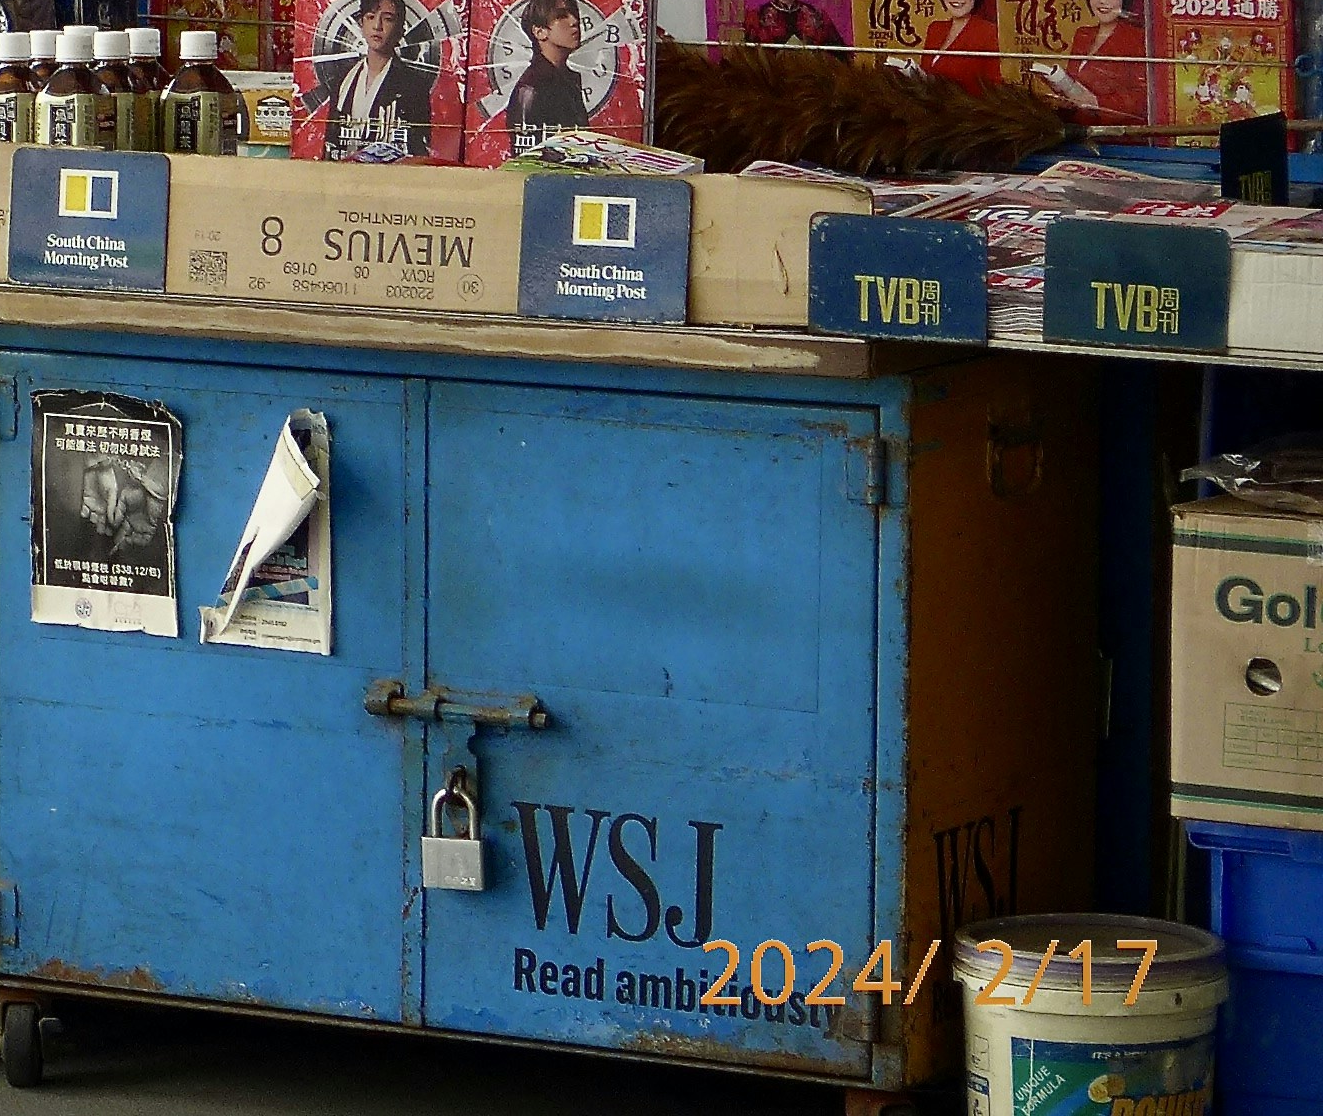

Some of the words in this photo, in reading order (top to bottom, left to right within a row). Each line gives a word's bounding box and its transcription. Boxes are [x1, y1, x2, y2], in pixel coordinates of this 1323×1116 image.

[337, 209, 418, 227] MENTHOL
[422, 215, 476, 229] GREEN
[46, 233, 83, 250] South
[86, 235, 126, 252] China
[260, 216, 284, 257] 8
[323, 227, 475, 270] MEVIUS
[43, 249, 98, 270] Morning
[100, 252, 129, 270] Post
[558, 263, 600, 281] South
[602, 265, 644, 283] China
[555, 280, 612, 303] Morning
[615, 283, 647, 301] Post
[512, 801, 724, 950] WSJ
[513, 947, 605, 1002] Read
[1015, 1065, 1052, 1102] UNIQUE
[1021, 1074, 1067, 1116] FORMULA
